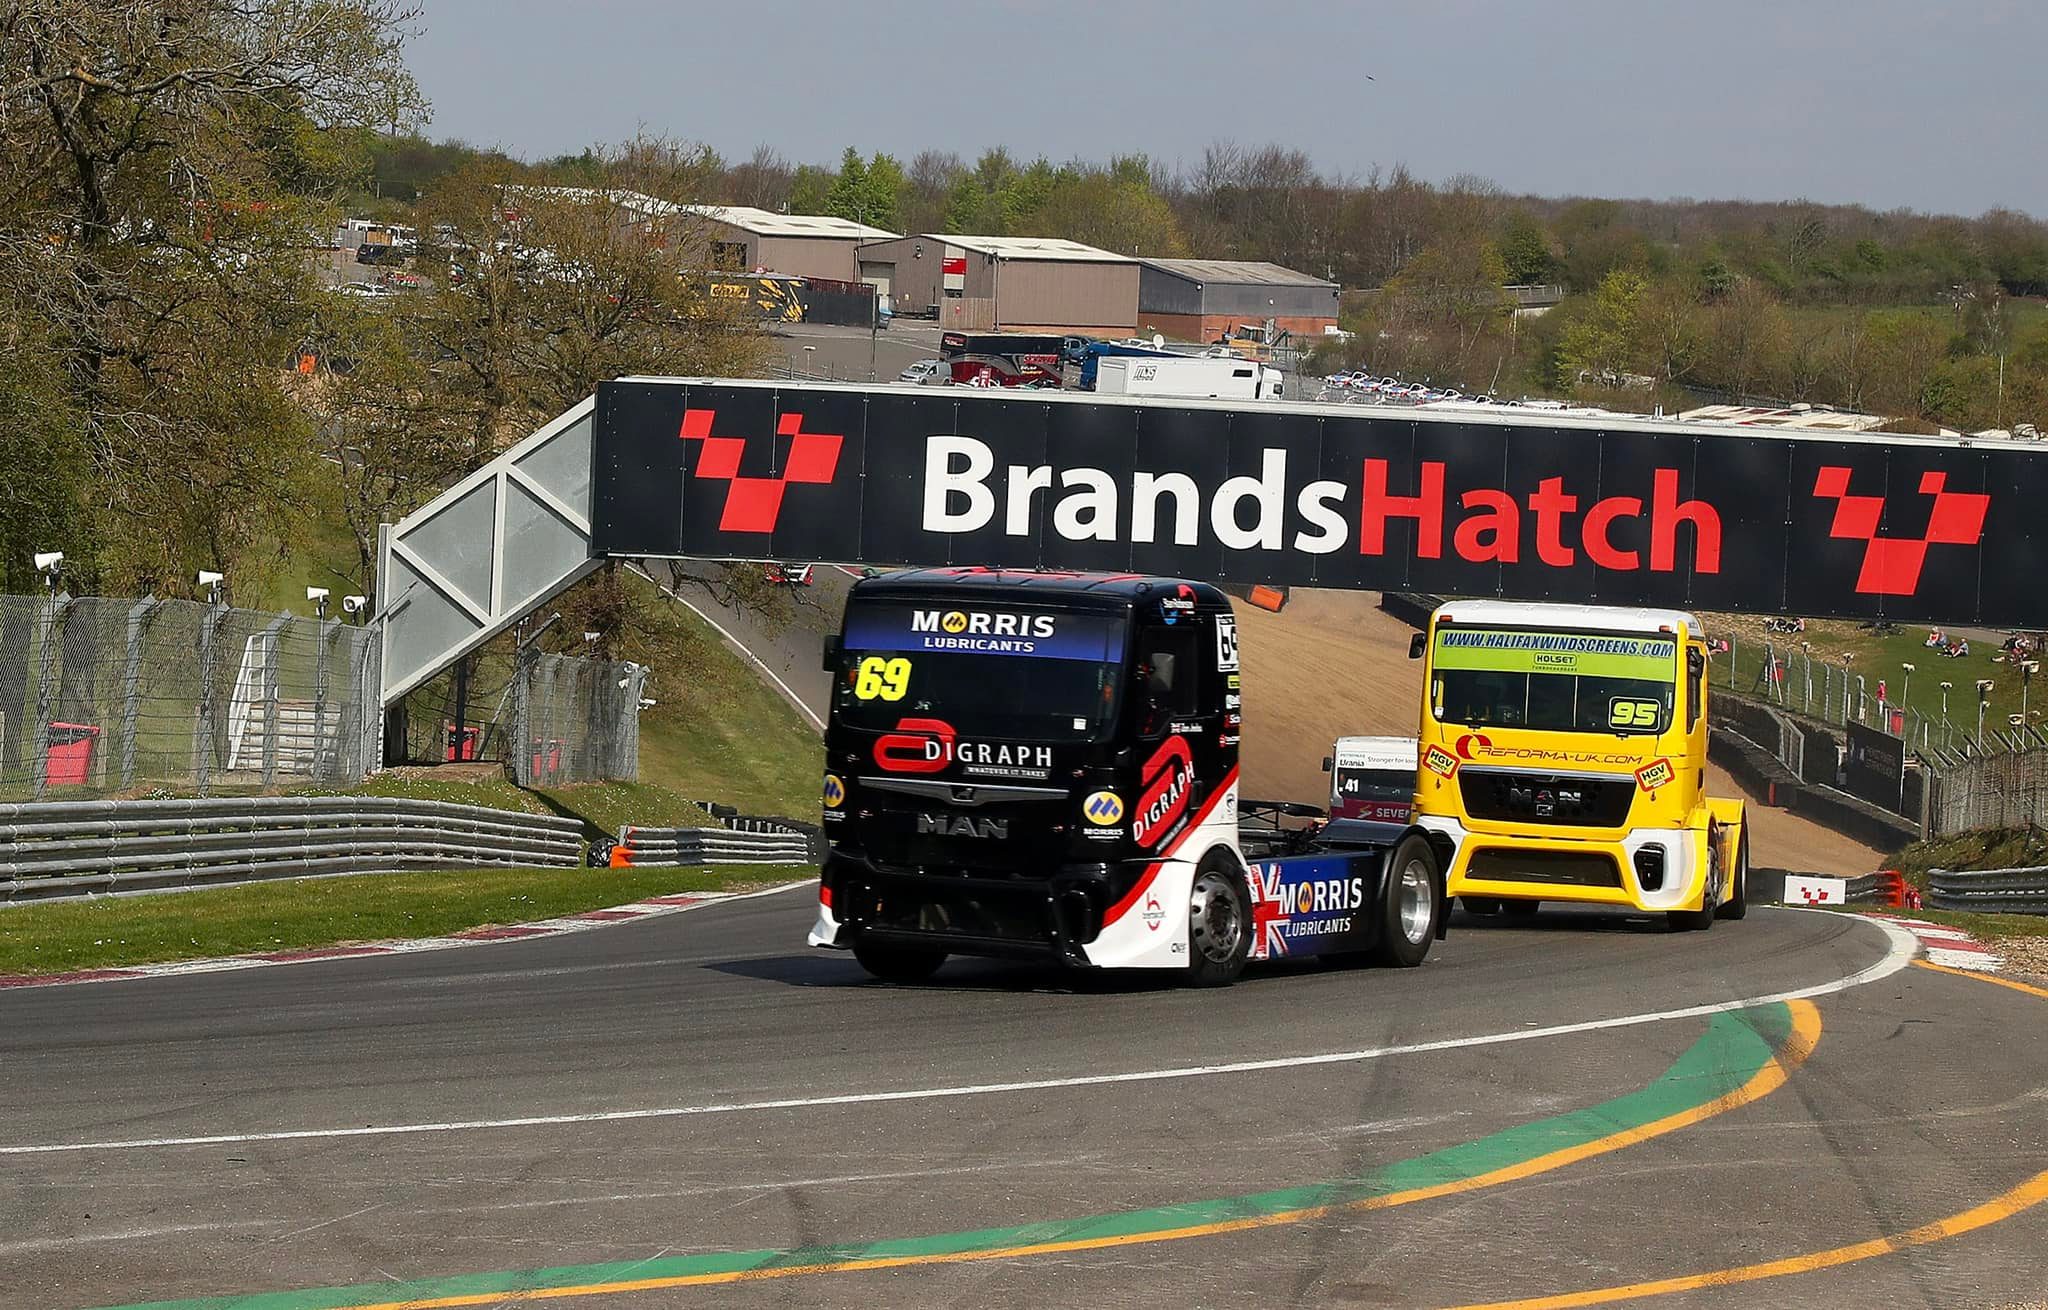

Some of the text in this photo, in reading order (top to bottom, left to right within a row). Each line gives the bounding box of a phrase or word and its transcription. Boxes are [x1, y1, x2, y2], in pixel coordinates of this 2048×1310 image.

[911, 610, 1055, 638] MORRIS
[924, 637, 1035, 652] LUBRICANTS
[1443, 633, 1674, 658] WWW.HALIFAXWINDSCREENS.COM
[1536, 655, 1574, 664] HOLSET
[855, 656, 912, 701] 69
[1611, 701, 1658, 726] 95
[925, 740, 1052, 767] DIGRAPH
[1430, 750, 1453, 767] HGV
[1345, 778, 1359, 792] 41
[1641, 764, 1665, 781] HGV
[1133, 761, 1195, 842] DIGRAPH
[917, 813, 1008, 839] MAN
[1278, 878, 1362, 915] MORRIS
[1285, 917, 1351, 938] LUBRICANTS
